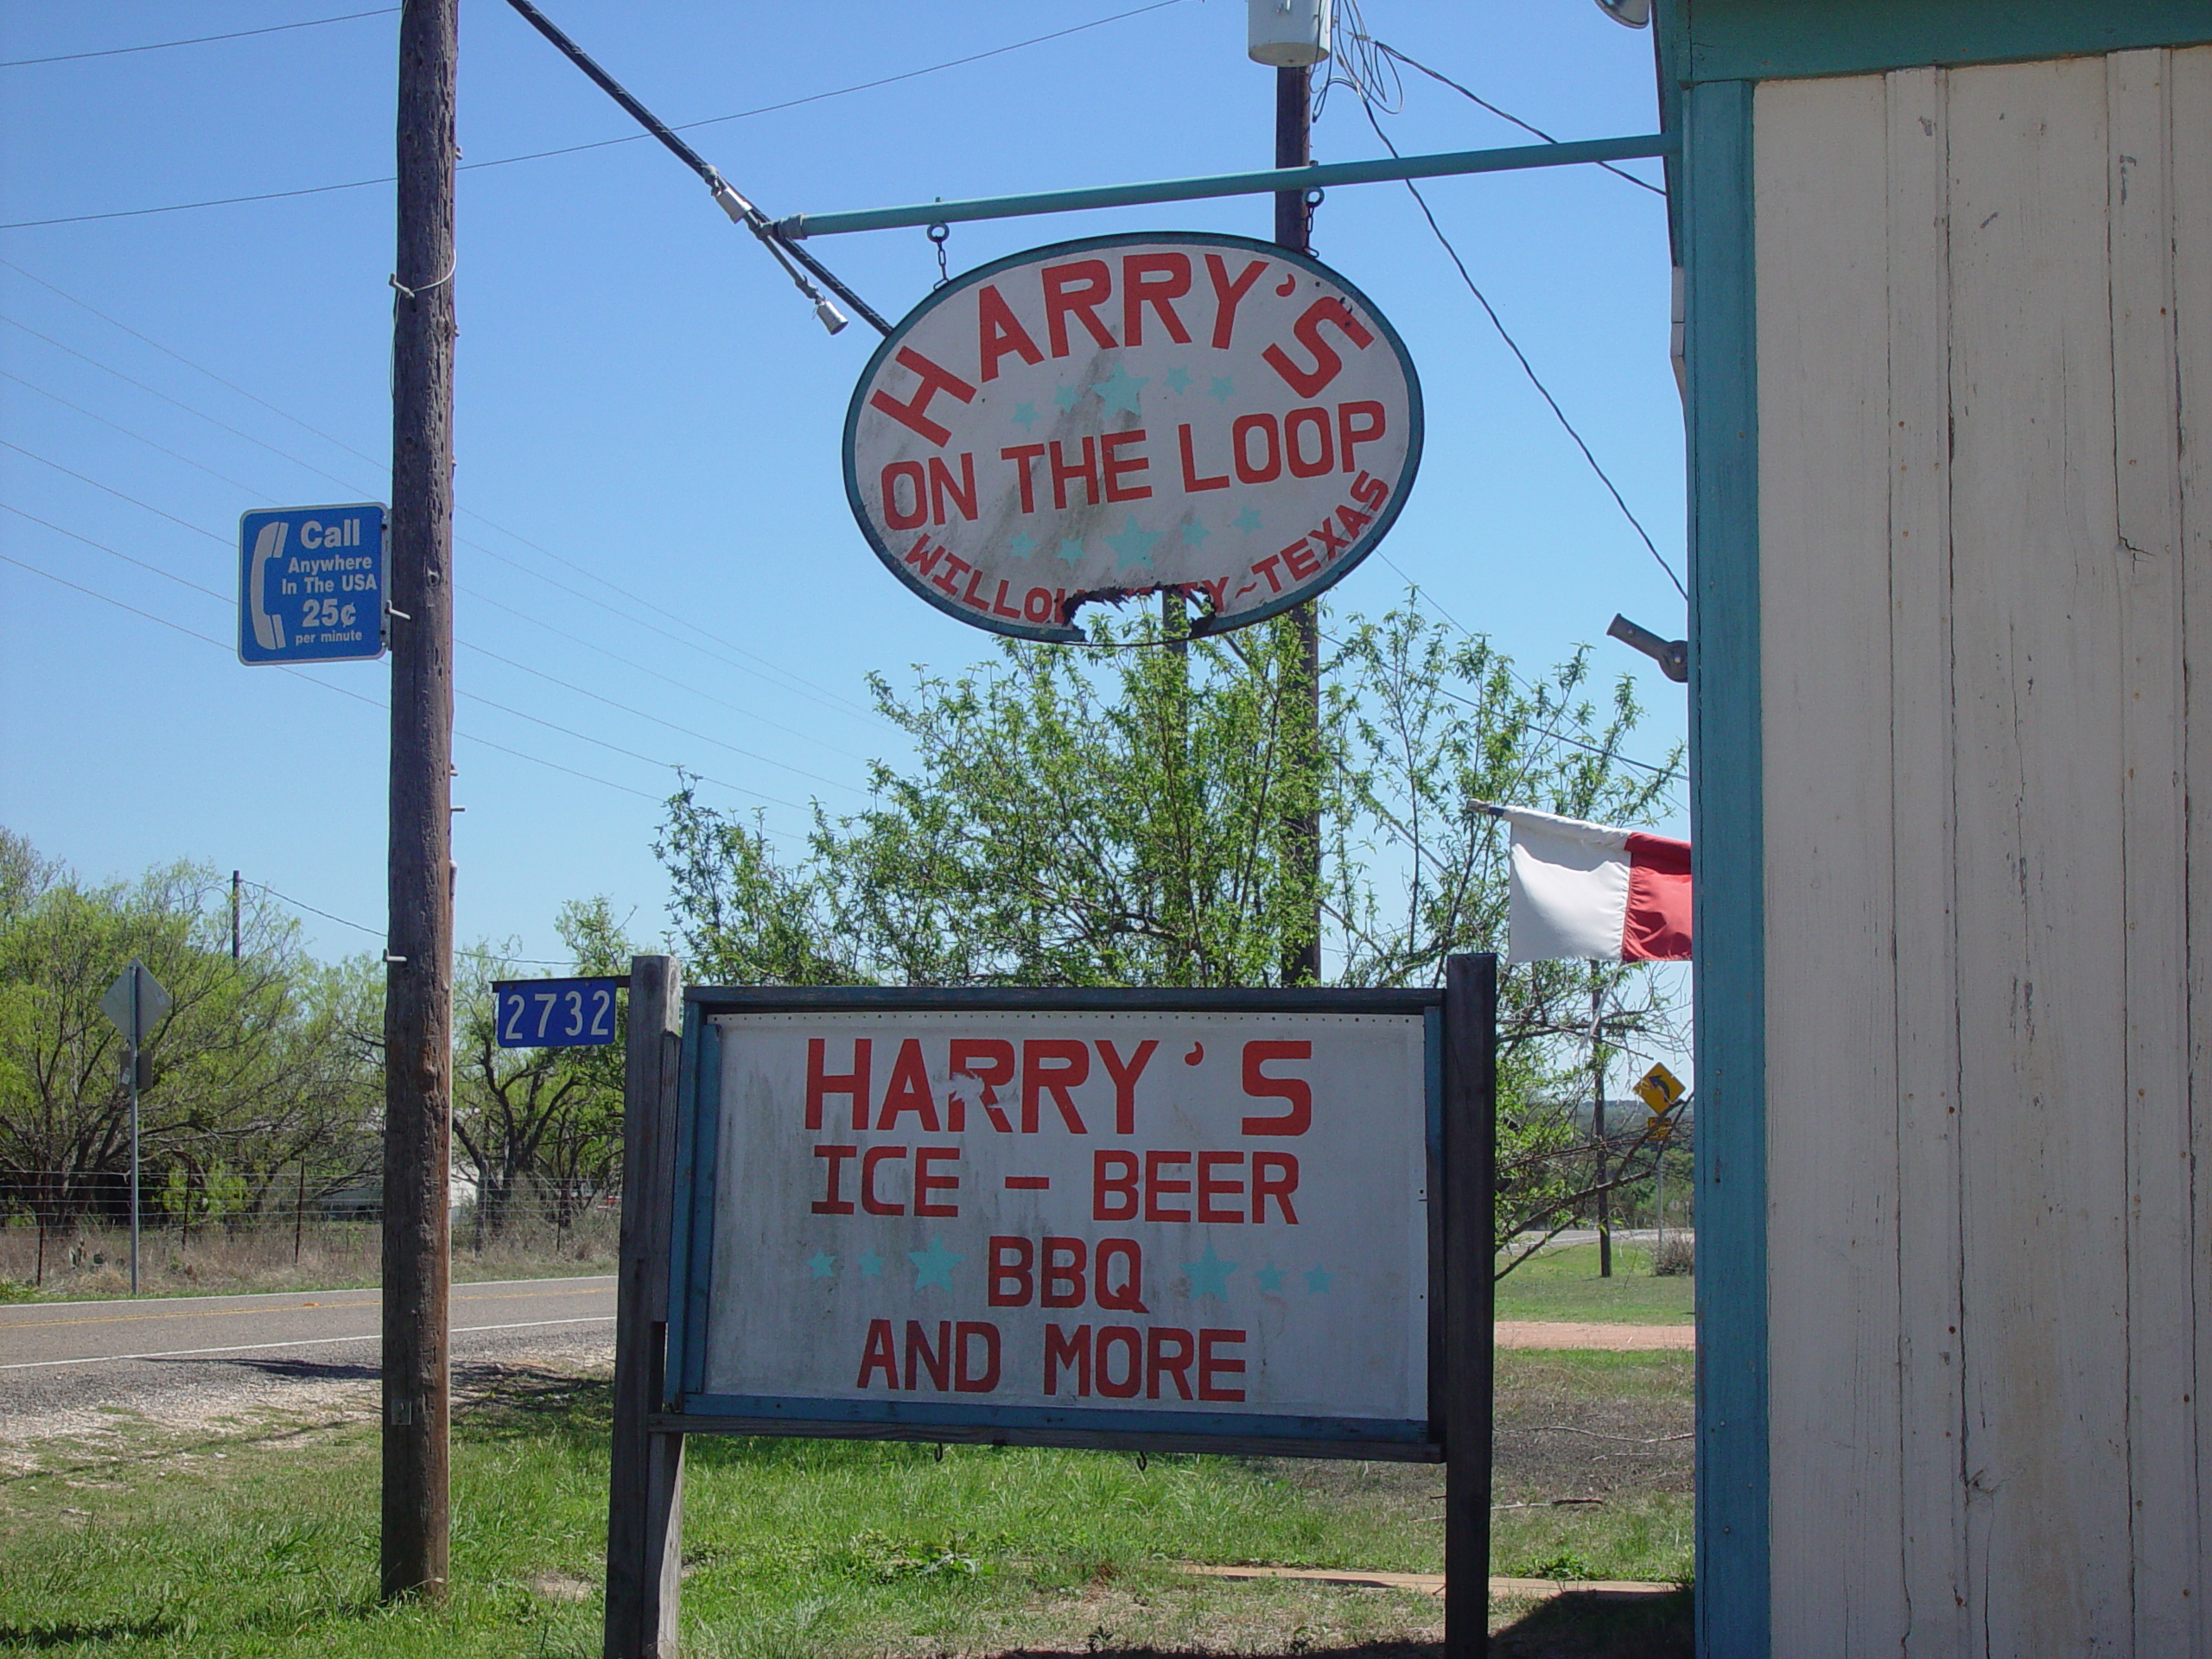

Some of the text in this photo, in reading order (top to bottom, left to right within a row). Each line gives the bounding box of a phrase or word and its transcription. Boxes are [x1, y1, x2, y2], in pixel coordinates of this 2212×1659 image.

[869, 252, 1375, 448] HARRY'S
[880, 400, 1386, 531] ON THE LOOP
[288, 554, 372, 575] Anywhere
[300, 518, 360, 550] Call
[282, 574, 378, 594] In The USA
[302, 598, 356, 627] 25¢
[296, 630, 363, 646] per minute
[505, 989, 611, 1039] 2732
[804, 1038, 1313, 1136] HARRY'S
[810, 1145, 961, 1217] ICE
[1092, 1149, 1300, 1225] BEER
[987, 1236, 1149, 1313] BBQ
[856, 1319, 1247, 1402] AND MORE
